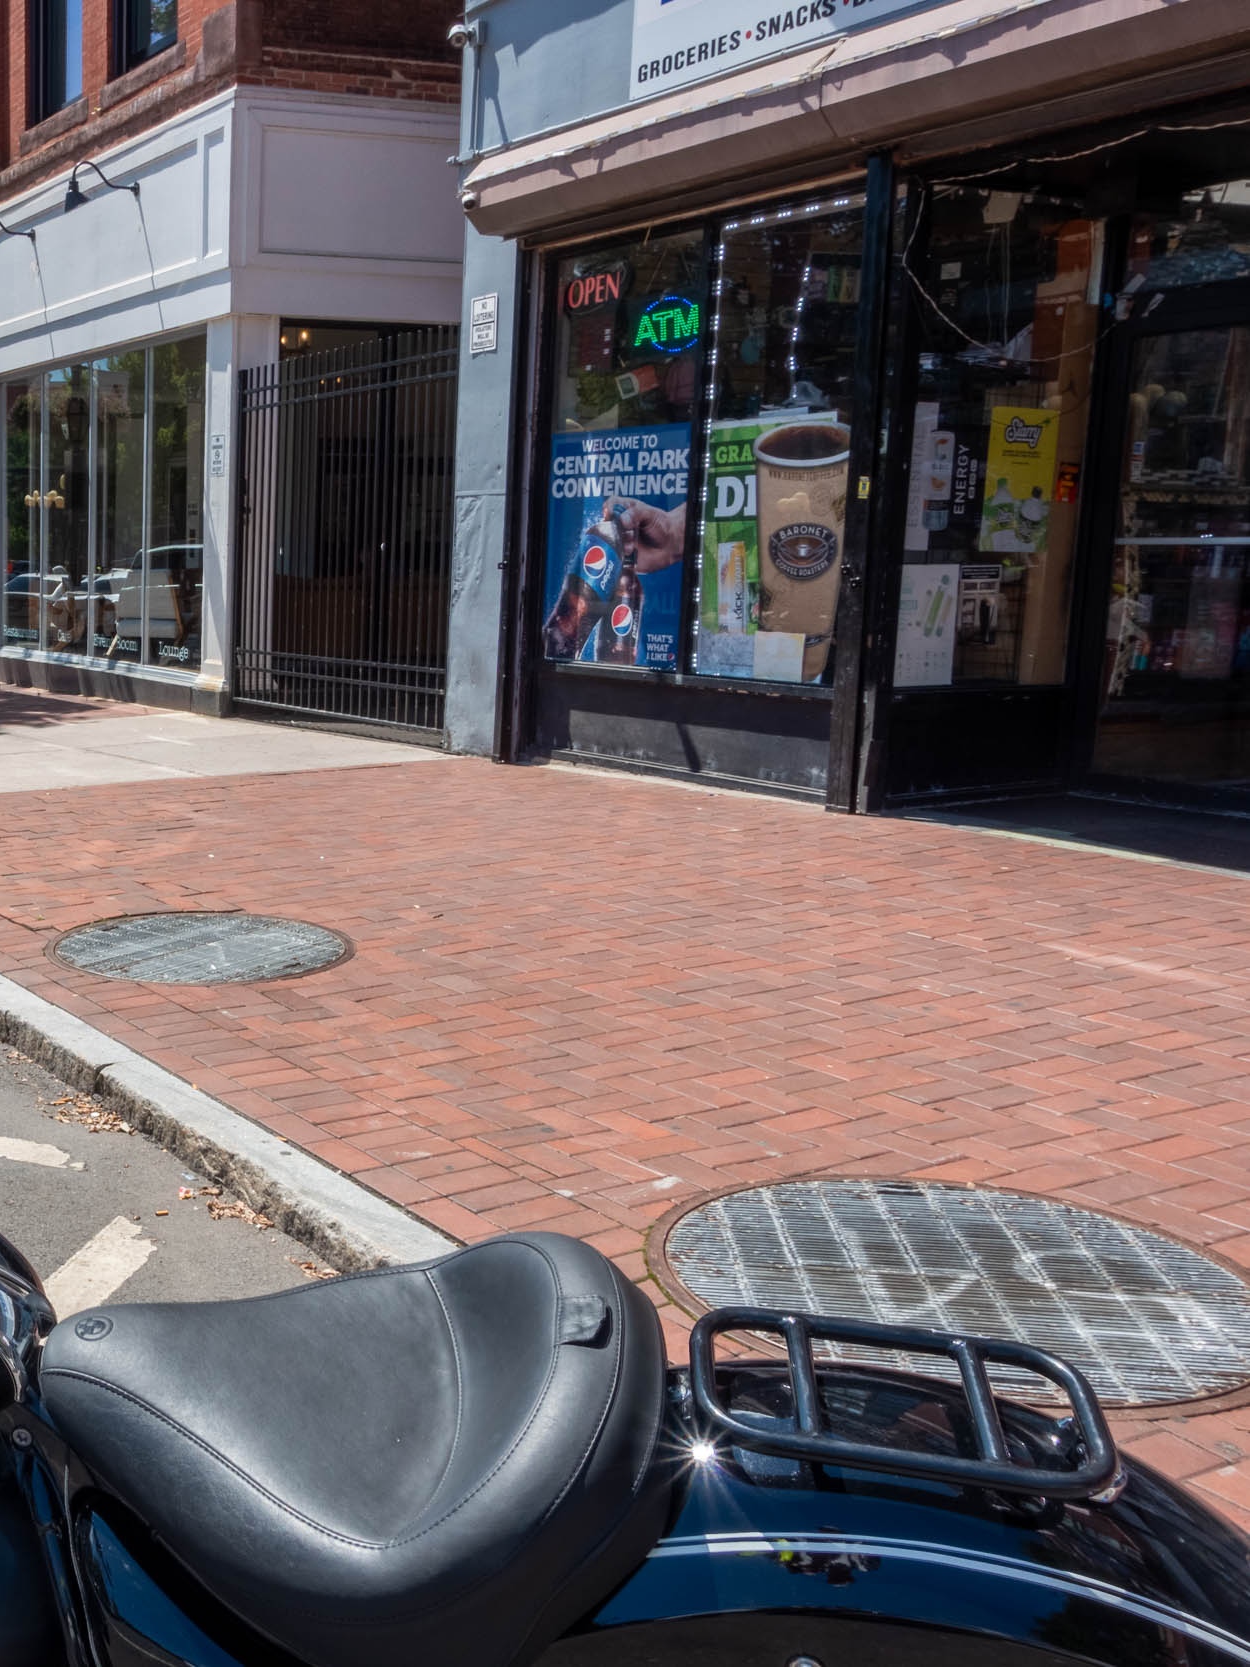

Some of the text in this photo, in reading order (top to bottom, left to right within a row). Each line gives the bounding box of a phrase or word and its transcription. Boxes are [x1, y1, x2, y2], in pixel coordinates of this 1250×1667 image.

[637, 0, 836, 83] GROCERIES SNACKS
[568, 271, 620, 309] OPEN
[634, 304, 699, 346] ATM
[582, 434, 658, 452] WELCOME TO
[553, 448, 690, 475] CENTRAL PARK
[715, 444, 756, 463] GRA
[552, 472, 689, 498] CONVENIENCE
[953, 444, 971, 515] ENERGY
[779, 525, 828, 539] BARONET
[600, 560, 615, 590] pepsi
[775, 560, 798, 576] COFFEE
[93, 633, 111, 648] Even
[646, 633, 674, 643] THAT'S
[646, 643, 670, 652] WHAT
[158, 641, 189, 662] Lounge
[651, 652, 668, 661] LIKE
